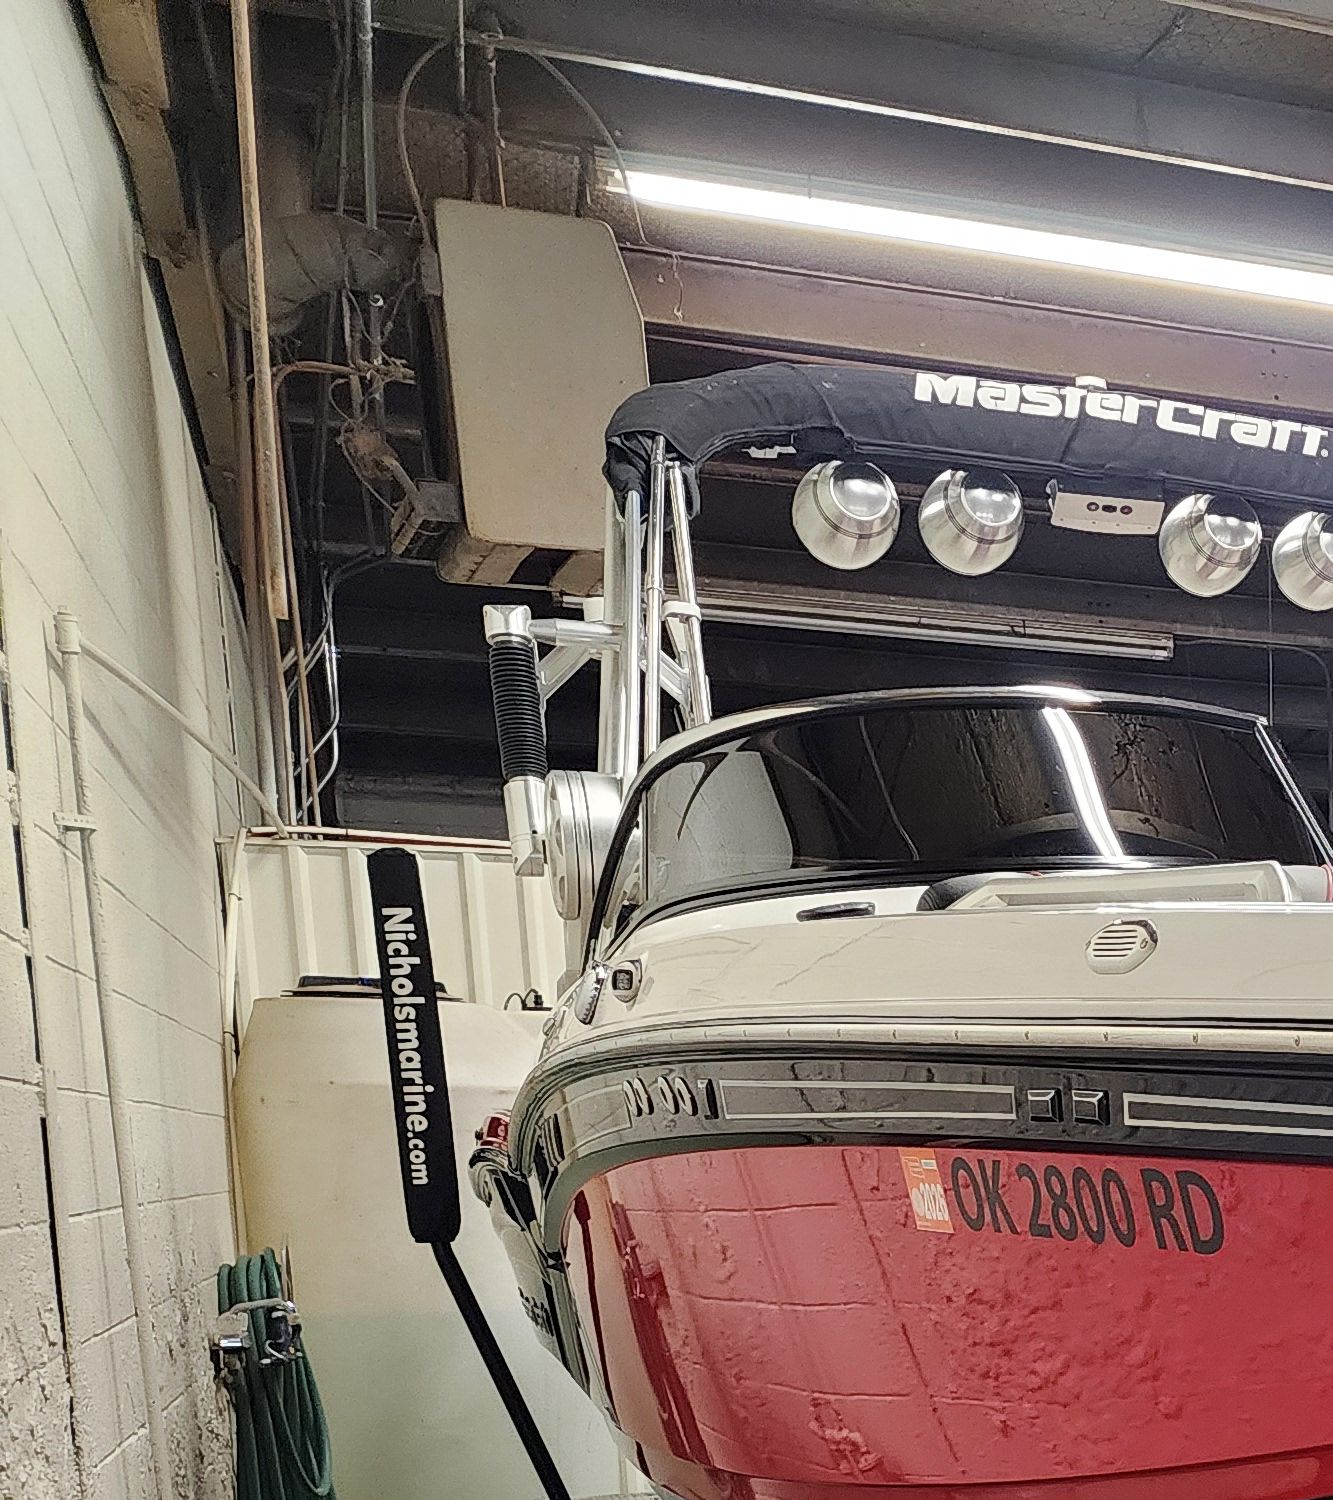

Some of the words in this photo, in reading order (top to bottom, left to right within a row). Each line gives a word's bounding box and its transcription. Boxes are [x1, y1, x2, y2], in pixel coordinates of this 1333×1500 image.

[381, 906, 435, 1186] Nicholsmarine.com
[951, 1156, 1021, 1235] OK
[1015, 1162, 1137, 1248] 2800
[1139, 1167, 1225, 1255] RD
